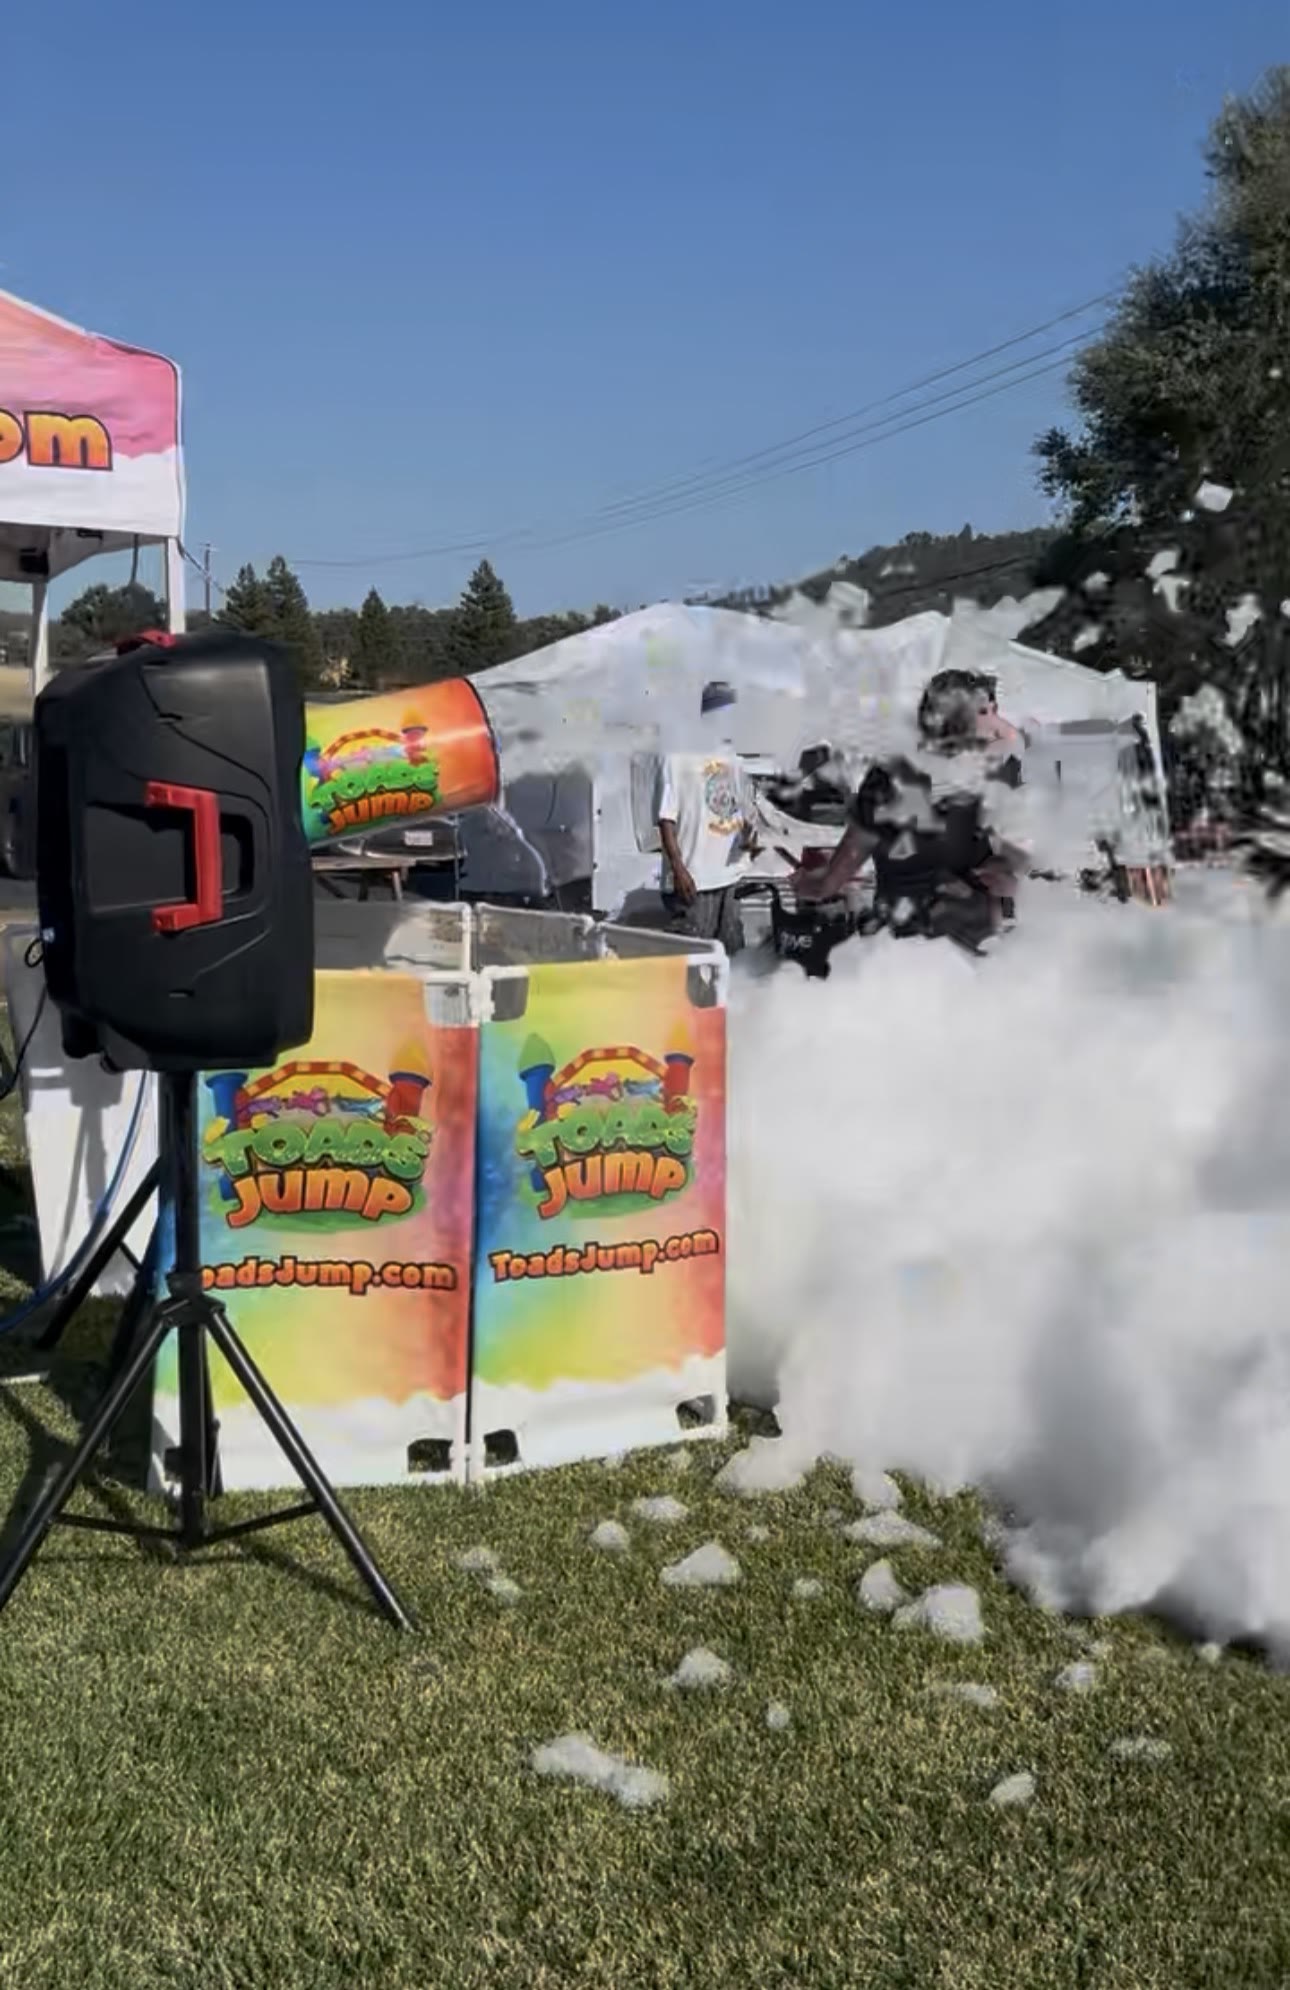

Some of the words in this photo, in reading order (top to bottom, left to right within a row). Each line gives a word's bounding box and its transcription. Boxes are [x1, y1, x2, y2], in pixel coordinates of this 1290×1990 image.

[202, 1119, 430, 1182] TOADS
[516, 1098, 694, 1168] TOADS
[201, 1256, 457, 1296] oadsJump.com
[488, 1229, 720, 1283] ToadsJump.com
